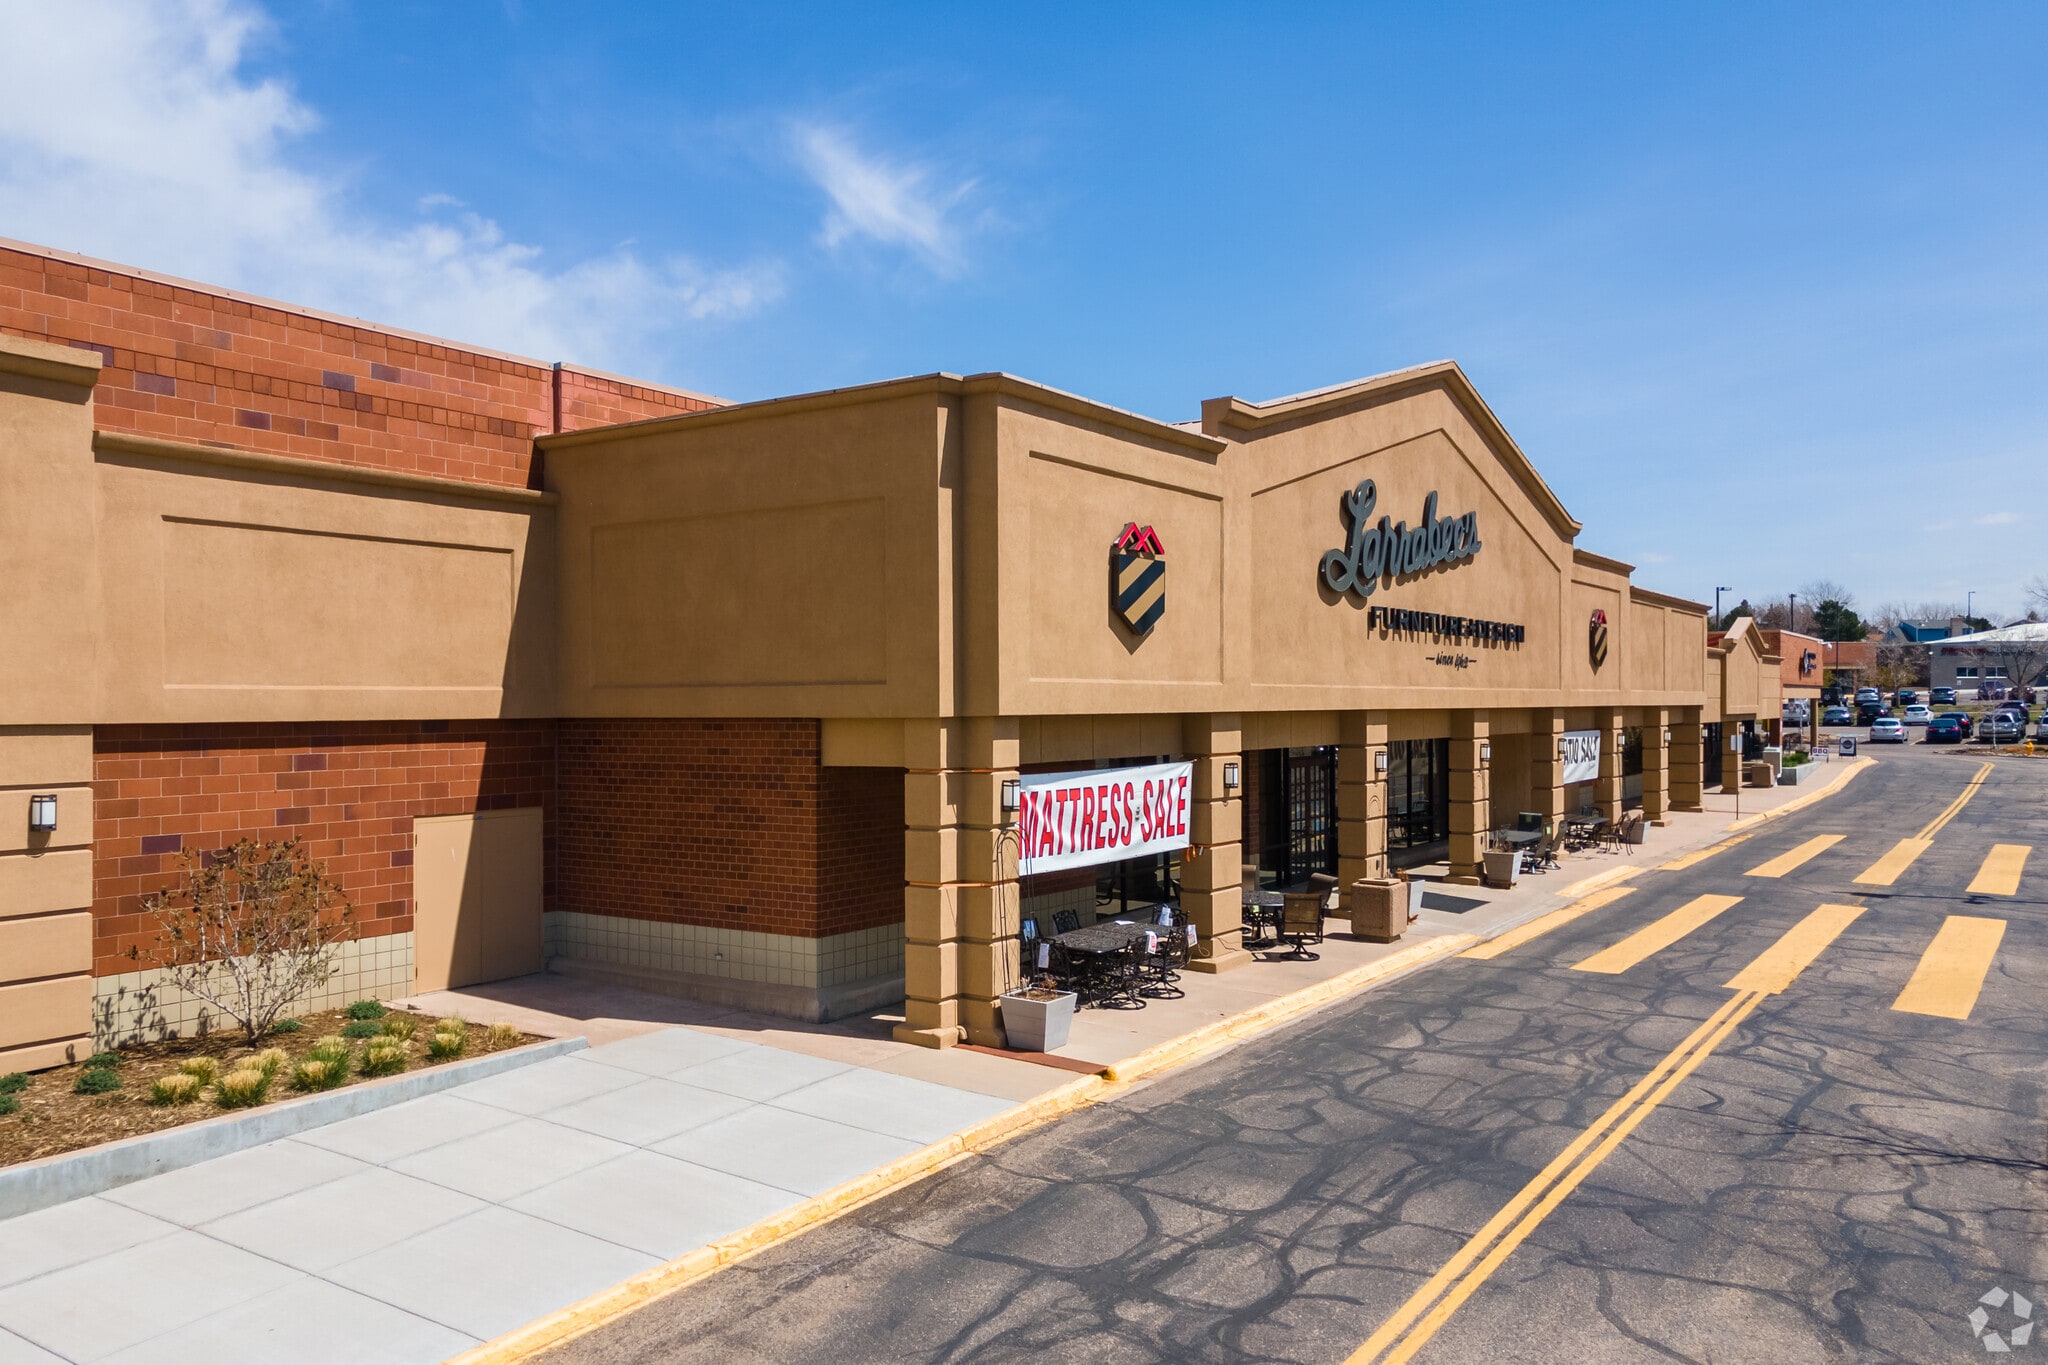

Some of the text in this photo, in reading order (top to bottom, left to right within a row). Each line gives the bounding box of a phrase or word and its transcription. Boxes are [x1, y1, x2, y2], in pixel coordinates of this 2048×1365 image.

[1321, 479, 1482, 597] Larrabee's
[1563, 738, 1579, 765] ATIO
[1019, 776, 1188, 860] MATTRESS SALE
